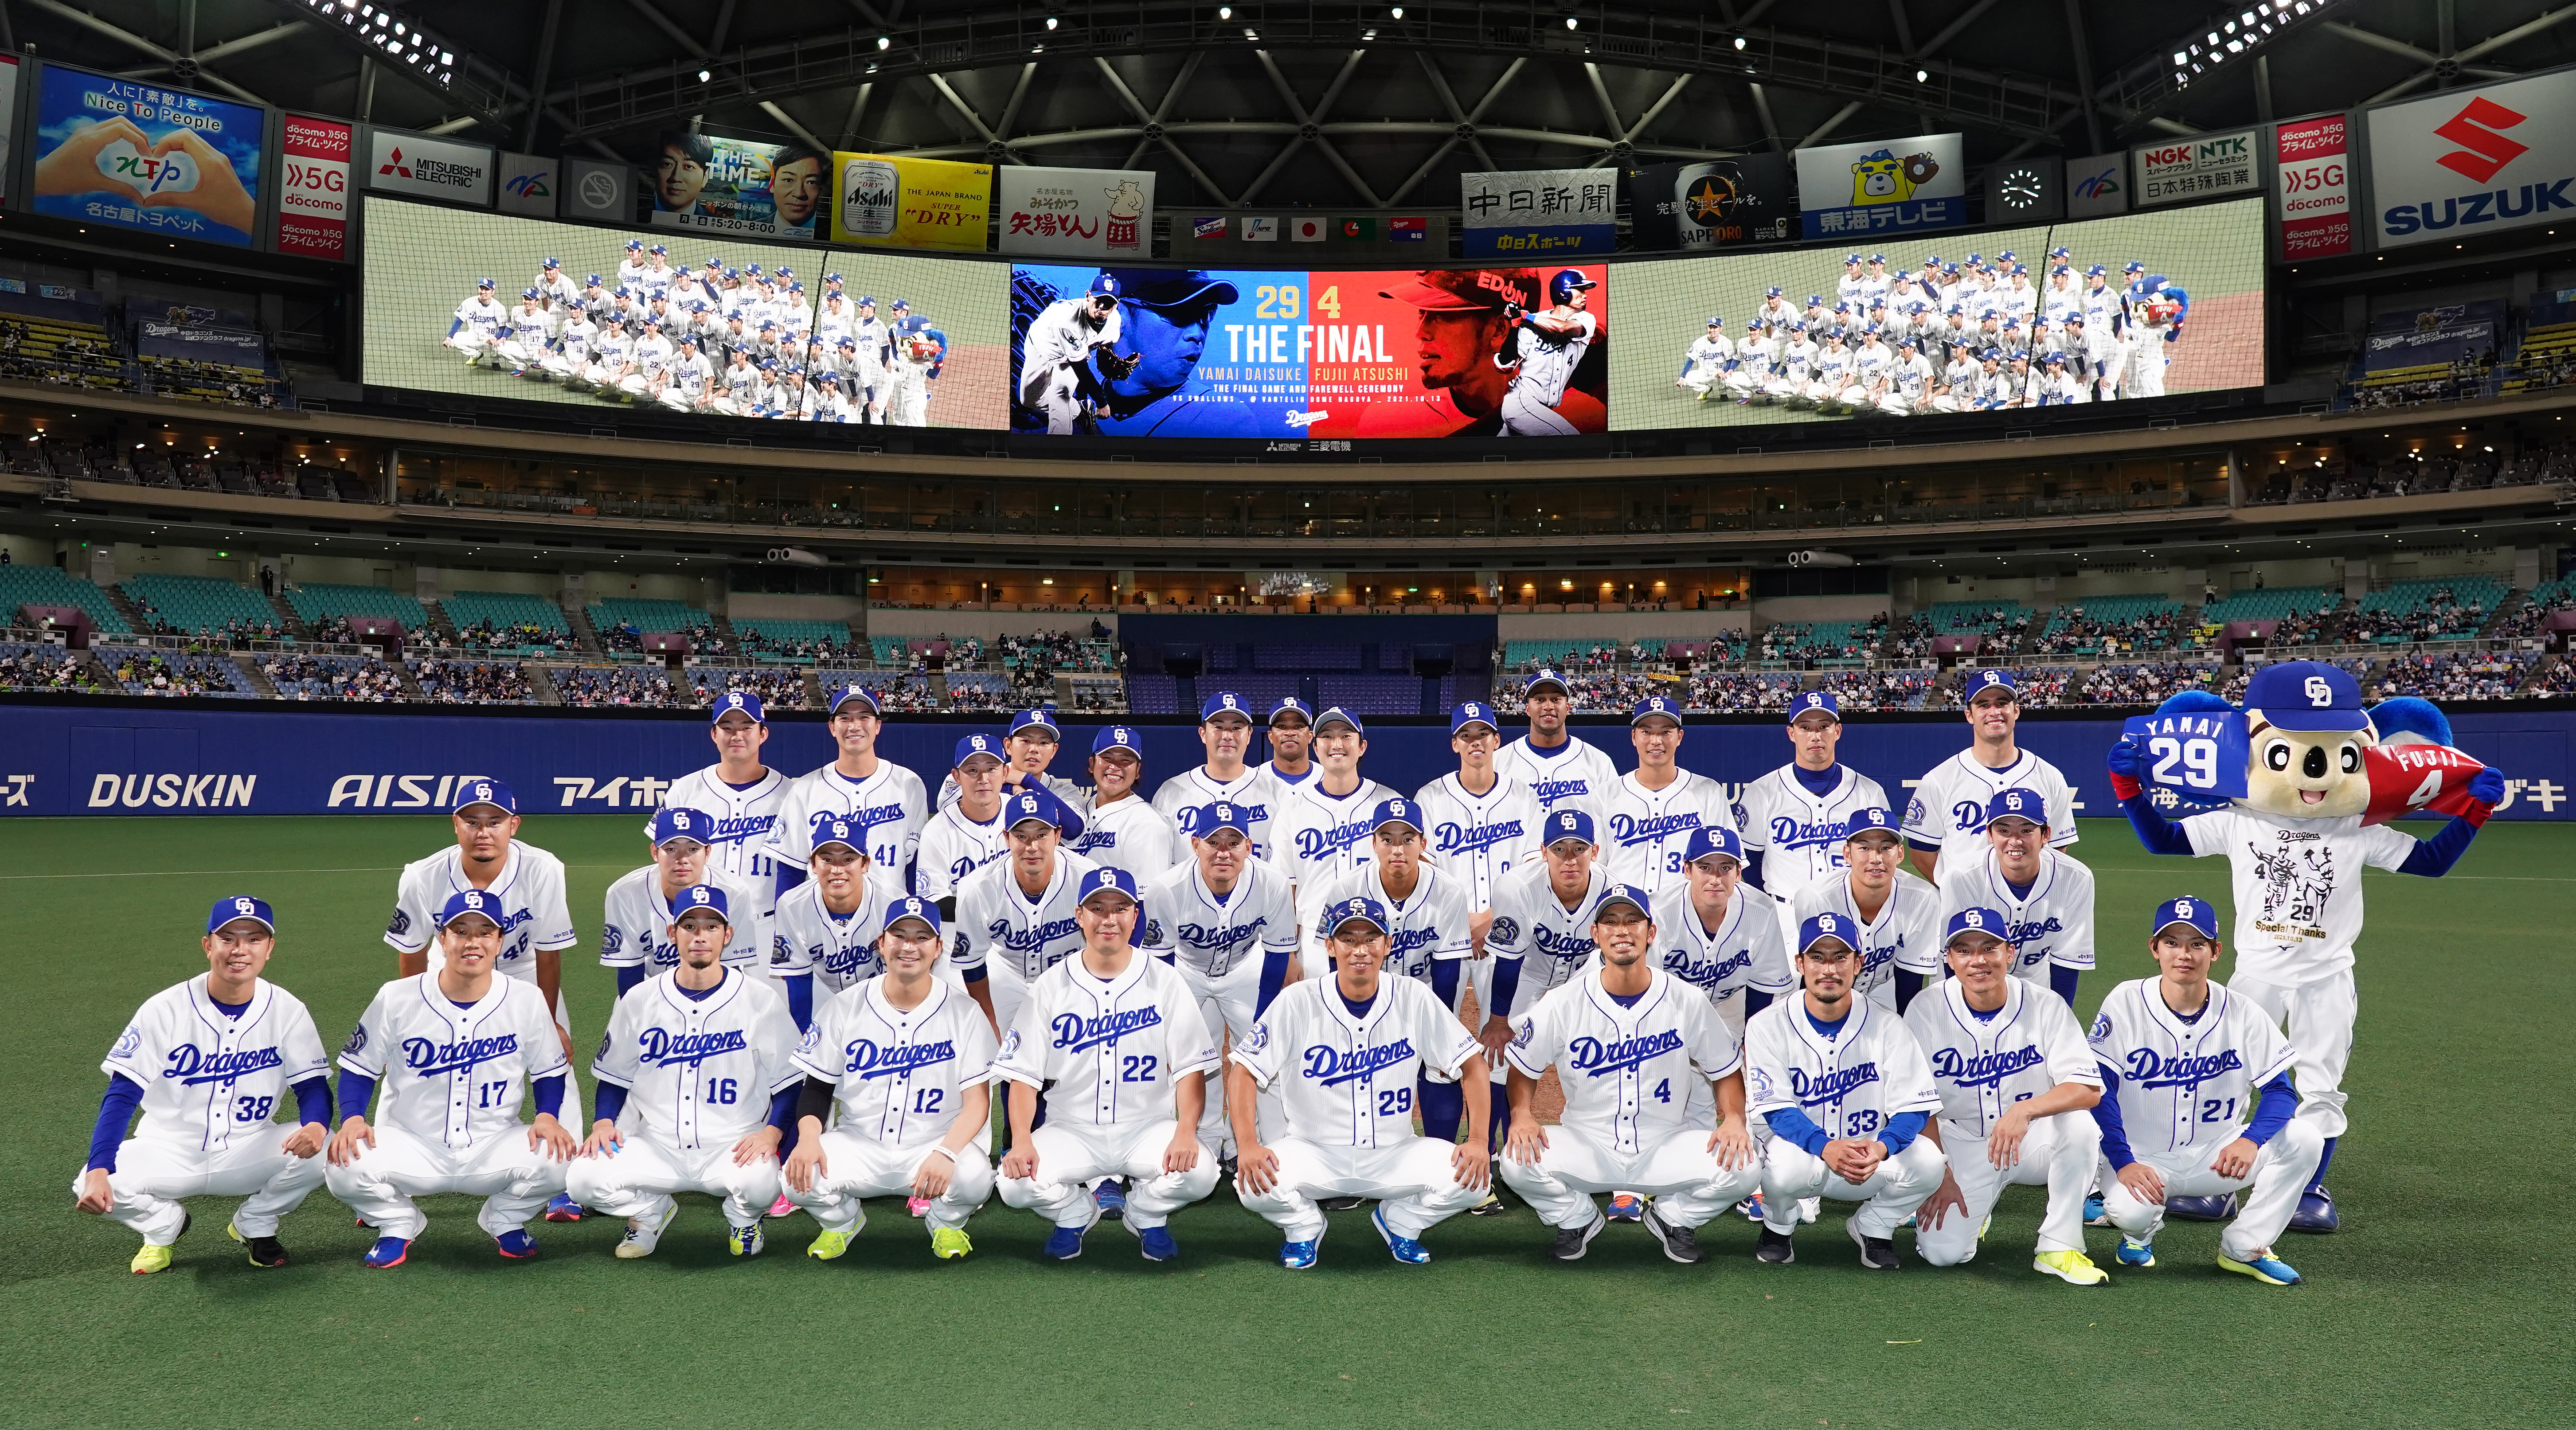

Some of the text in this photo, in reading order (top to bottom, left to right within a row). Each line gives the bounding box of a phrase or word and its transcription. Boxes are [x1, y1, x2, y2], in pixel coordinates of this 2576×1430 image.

[86, 93, 220, 130] Nice To People
[287, 125, 325, 137] docomo
[287, 134, 348, 151] プライム・ツイン
[2281, 129, 2319, 141] docomo
[2200, 137, 2248, 160] NTK
[2282, 134, 2344, 152] プライム・ツイン
[416, 158, 482, 177] MITSUBISHI
[718, 150, 751, 165] THE
[2146, 145, 2192, 168] NGK
[2200, 153, 2248, 168] ニューセラミック
[415, 169, 473, 188] ELECTRIC
[2146, 163, 2193, 176] スパークプラグ
[2147, 168, 2250, 199] 日本特殊陶業
[285, 193, 343, 211] docomo
[848, 187, 892, 207] Asahi
[925, 190, 952, 199] JAPAN
[954, 192, 982, 201] BRAND
[931, 202, 961, 211] SUPER
[1029, 197, 1079, 211] みそかつ
[1468, 185, 1611, 217] 中日新聞
[2287, 195, 2345, 211] docomo
[86, 202, 204, 233] 名古屋トヨペット
[1009, 211, 1098, 238] 矢場とん
[1820, 201, 1947, 233] 東海テレビ
[283, 224, 320, 235] docomo
[1681, 226, 1742, 244] SAPPORO
[2287, 229, 2325, 239] docomo
[1497, 232, 1582, 251] 中日スポーツ
[1256, 285, 1341, 319] 29 4
[145, 323, 178, 336] Dragons
[1224, 324, 1393, 363] THE FINAL
[1199, 367, 1408, 381] YAMAI DAISUKE FUJII ATSUSHI
[1214, 384, 1404, 393] THE FINAL GAME AND FAREWELL CEREMONY
[1285, 409, 1329, 428] Dragons
[1309, 441, 1352, 452] 三菱電機
[2146, 717, 2223, 738] YAMAI
[2149, 738, 2217, 789] 29
[2397, 749, 2458, 772] FUJII
[2407, 769, 2443, 809] 4
[1435, 819, 1524, 857] Dragons
[1610, 812, 1702, 848] Dragons
[2277, 830, 2321, 842] Dragons
[751, 853, 772, 877] 11
[875, 844, 896, 867] 41
[2255, 864, 2265, 879] 4
[2290, 904, 2314, 921] 29
[2255, 920, 2326, 938] Special Thanks
[2274, 934, 2302, 942] 2021.10.13
[503, 932, 528, 961] 46
[1052, 1004, 1162, 1055] Dragons
[402, 1033, 518, 1078] Dragons
[639, 1027, 747, 1068] Dragons
[1570, 1028, 1684, 1079] Dragons
[163, 1043, 283, 1087] Dragons
[846, 1039, 956, 1080] Dragons
[1122, 1055, 1157, 1082] 22
[1303, 1037, 1415, 1088] Dragons
[1932, 1043, 2044, 1089] Dragons
[2124, 1047, 2243, 1093] Dragons
[478, 1080, 508, 1108] 17
[707, 1078, 737, 1104] 16
[1654, 1078, 1671, 1103] 4
[1789, 1061, 1879, 1109] Dragons
[235, 1096, 274, 1122] 38
[914, 1089, 944, 1113] 12
[1379, 1087, 1412, 1117] 29
[2201, 1097, 2236, 1123] 21
[1847, 1109, 1879, 1137] 33
